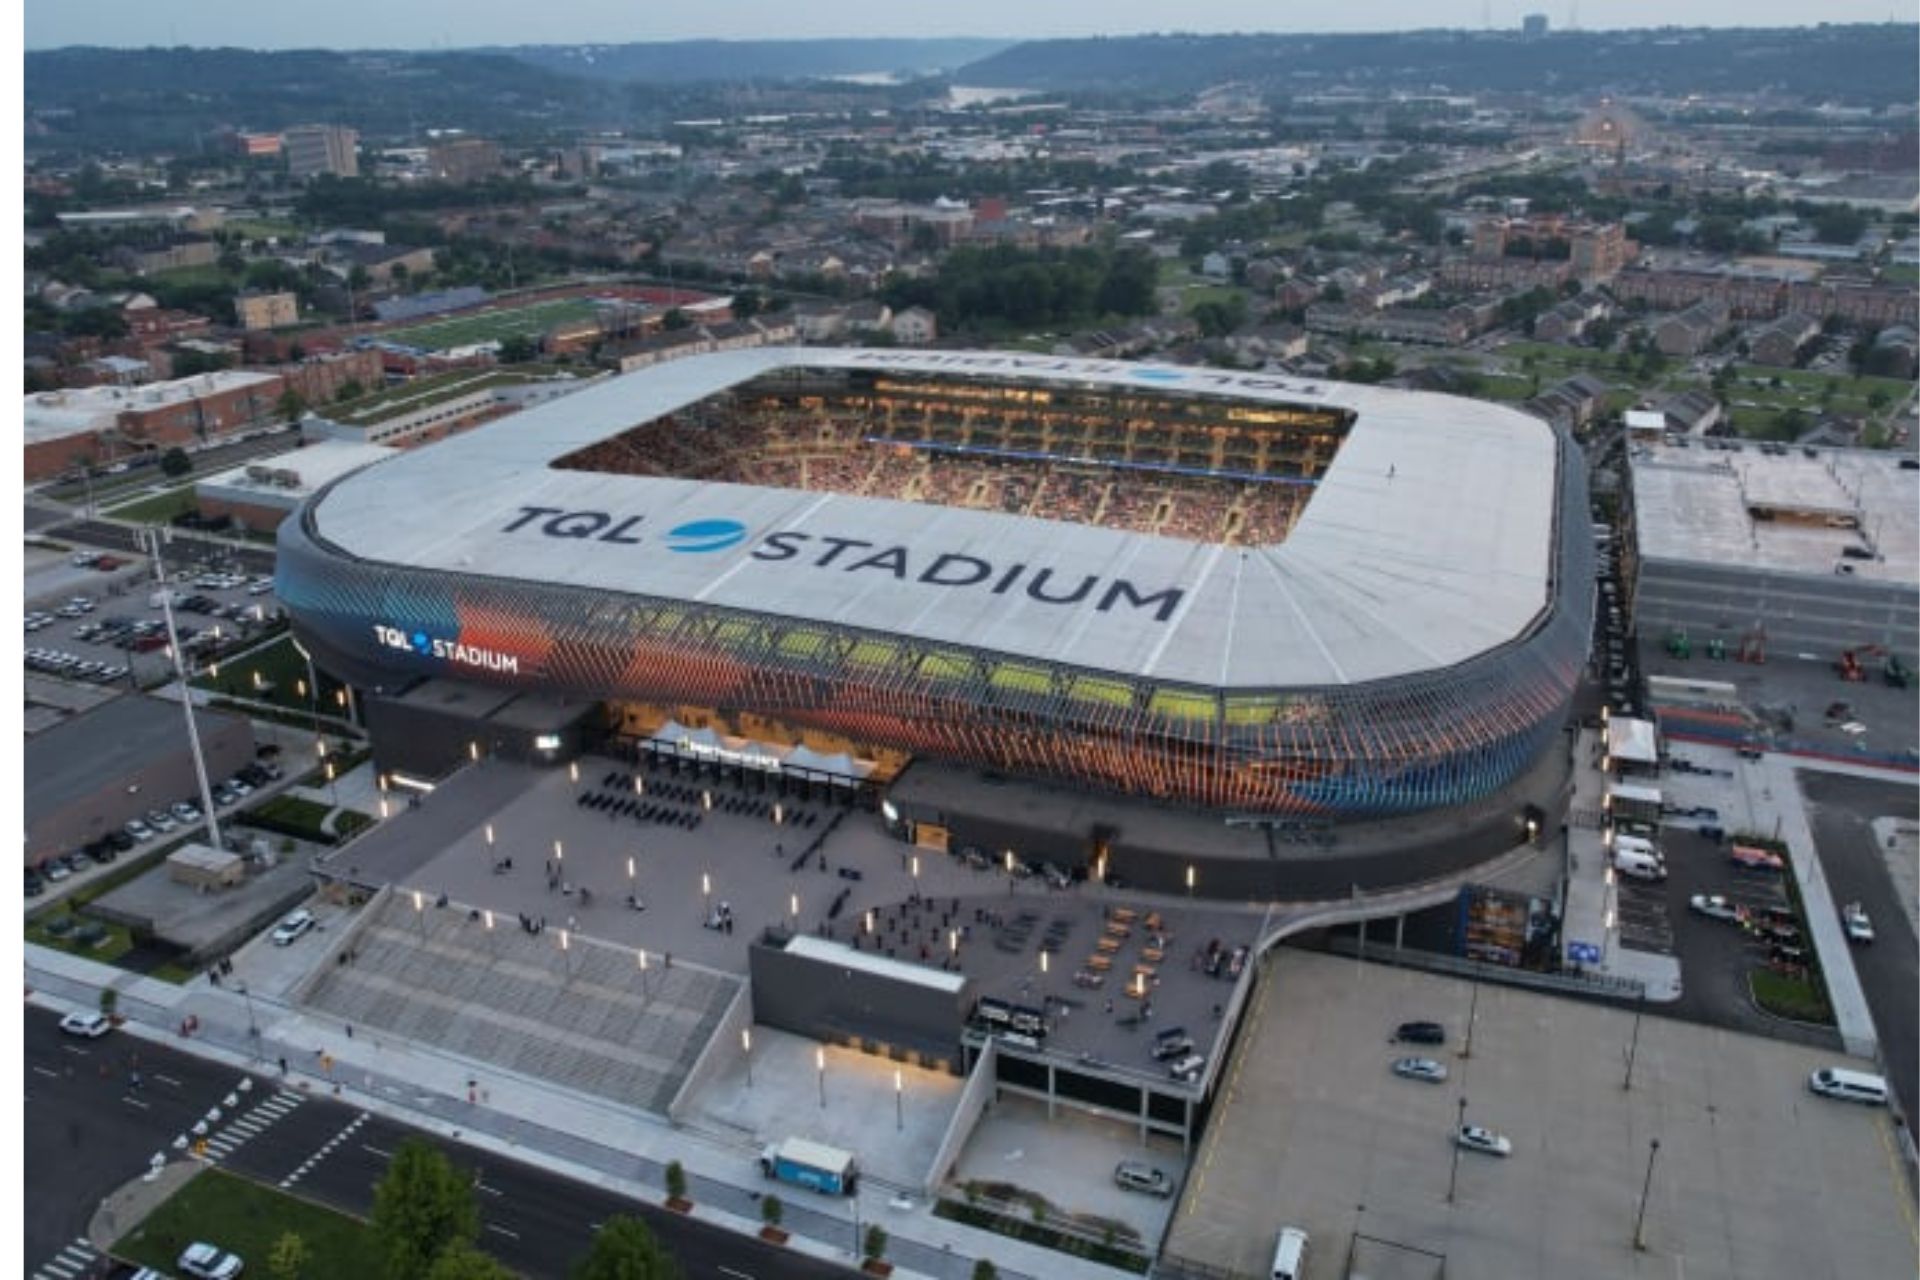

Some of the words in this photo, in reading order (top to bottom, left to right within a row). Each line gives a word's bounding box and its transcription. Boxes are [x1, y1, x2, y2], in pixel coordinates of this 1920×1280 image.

[1202, 375, 1326, 396] TQL
[500, 506, 645, 544] TQL
[751, 531, 1186, 622] STADIUM
[373, 625, 413, 651] TQL
[432, 639, 518, 675] STADIUM
